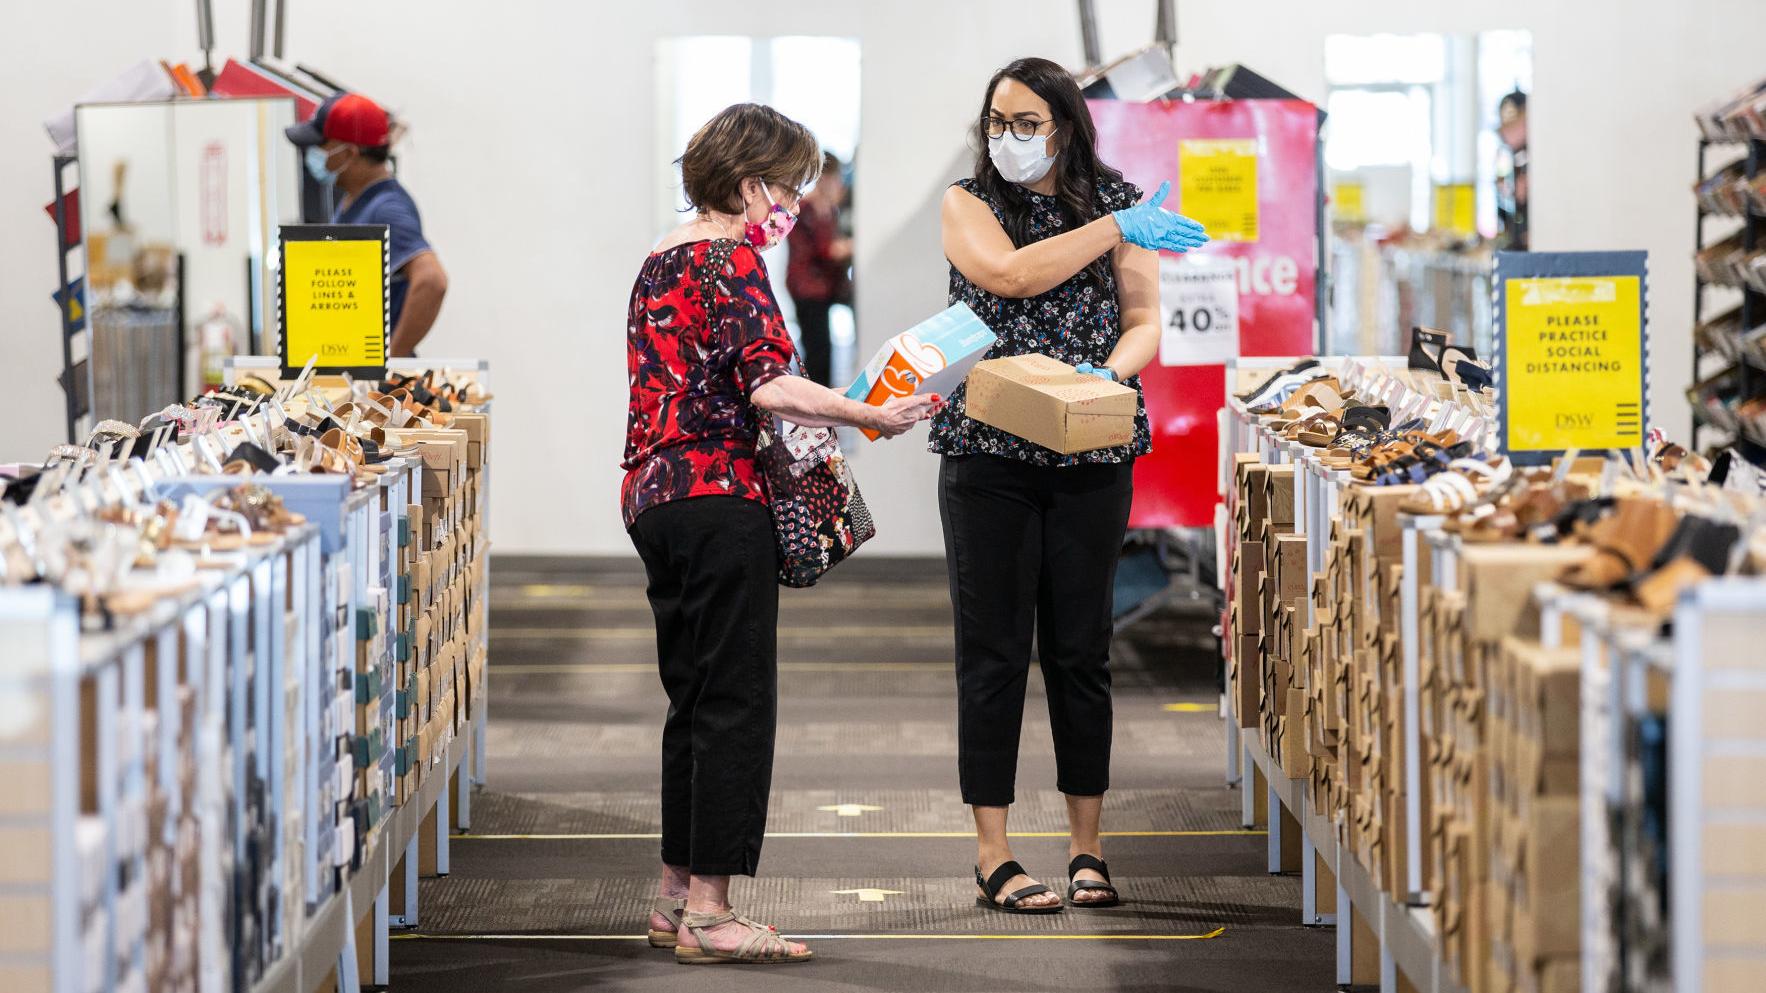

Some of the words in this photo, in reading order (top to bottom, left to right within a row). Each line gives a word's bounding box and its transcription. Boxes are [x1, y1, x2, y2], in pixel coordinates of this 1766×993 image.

[314, 268, 353, 277] PLEASE
[311, 279, 357, 288] FOLLOW
[312, 291, 343, 299] LINES
[310, 302, 359, 311] ARROWS
[1546, 314, 1599, 326] PLEASE
[1538, 330, 1608, 342] PRACTICE
[1546, 346, 1601, 358] SOCIAL
[1525, 360, 1622, 374] DISTANCING
[1554, 413, 1595, 427] DSW
